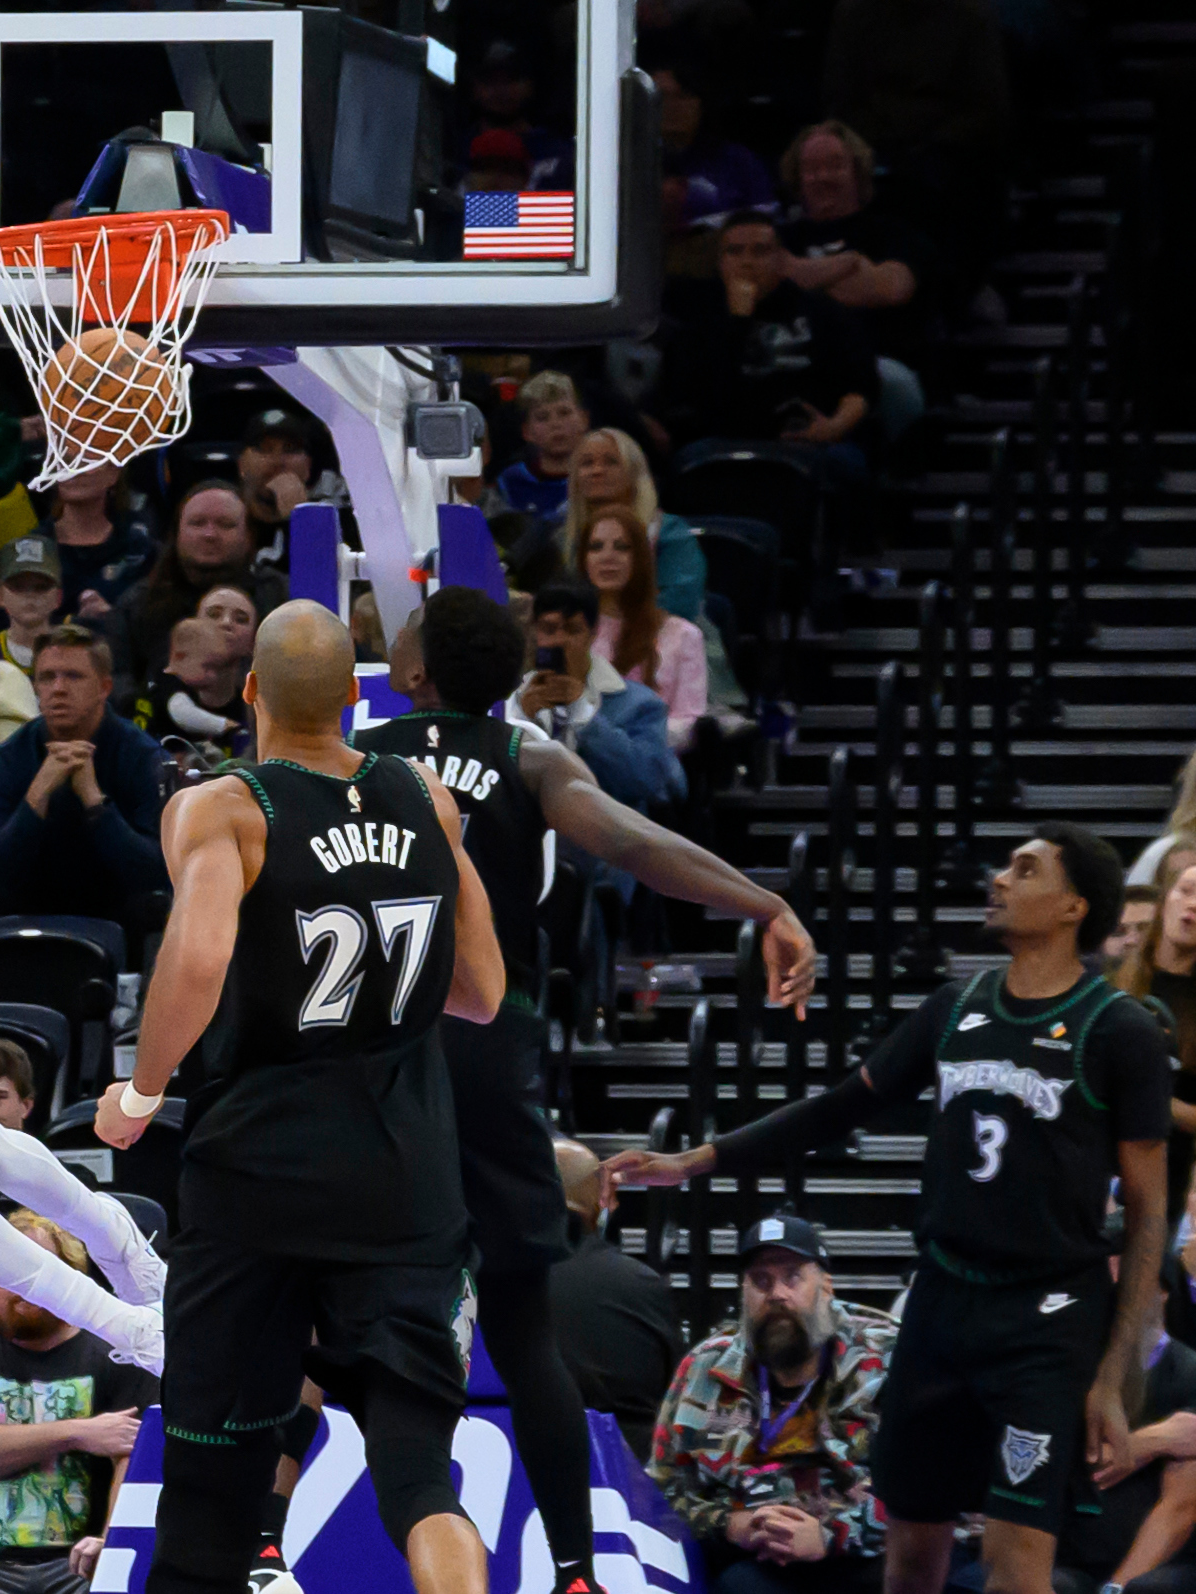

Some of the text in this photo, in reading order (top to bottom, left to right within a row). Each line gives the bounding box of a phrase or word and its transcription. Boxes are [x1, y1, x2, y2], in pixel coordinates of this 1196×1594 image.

[310, 822, 416, 873] GOBERT
[295, 895, 443, 1032] 27
[967, 1109, 1010, 1183] 3
